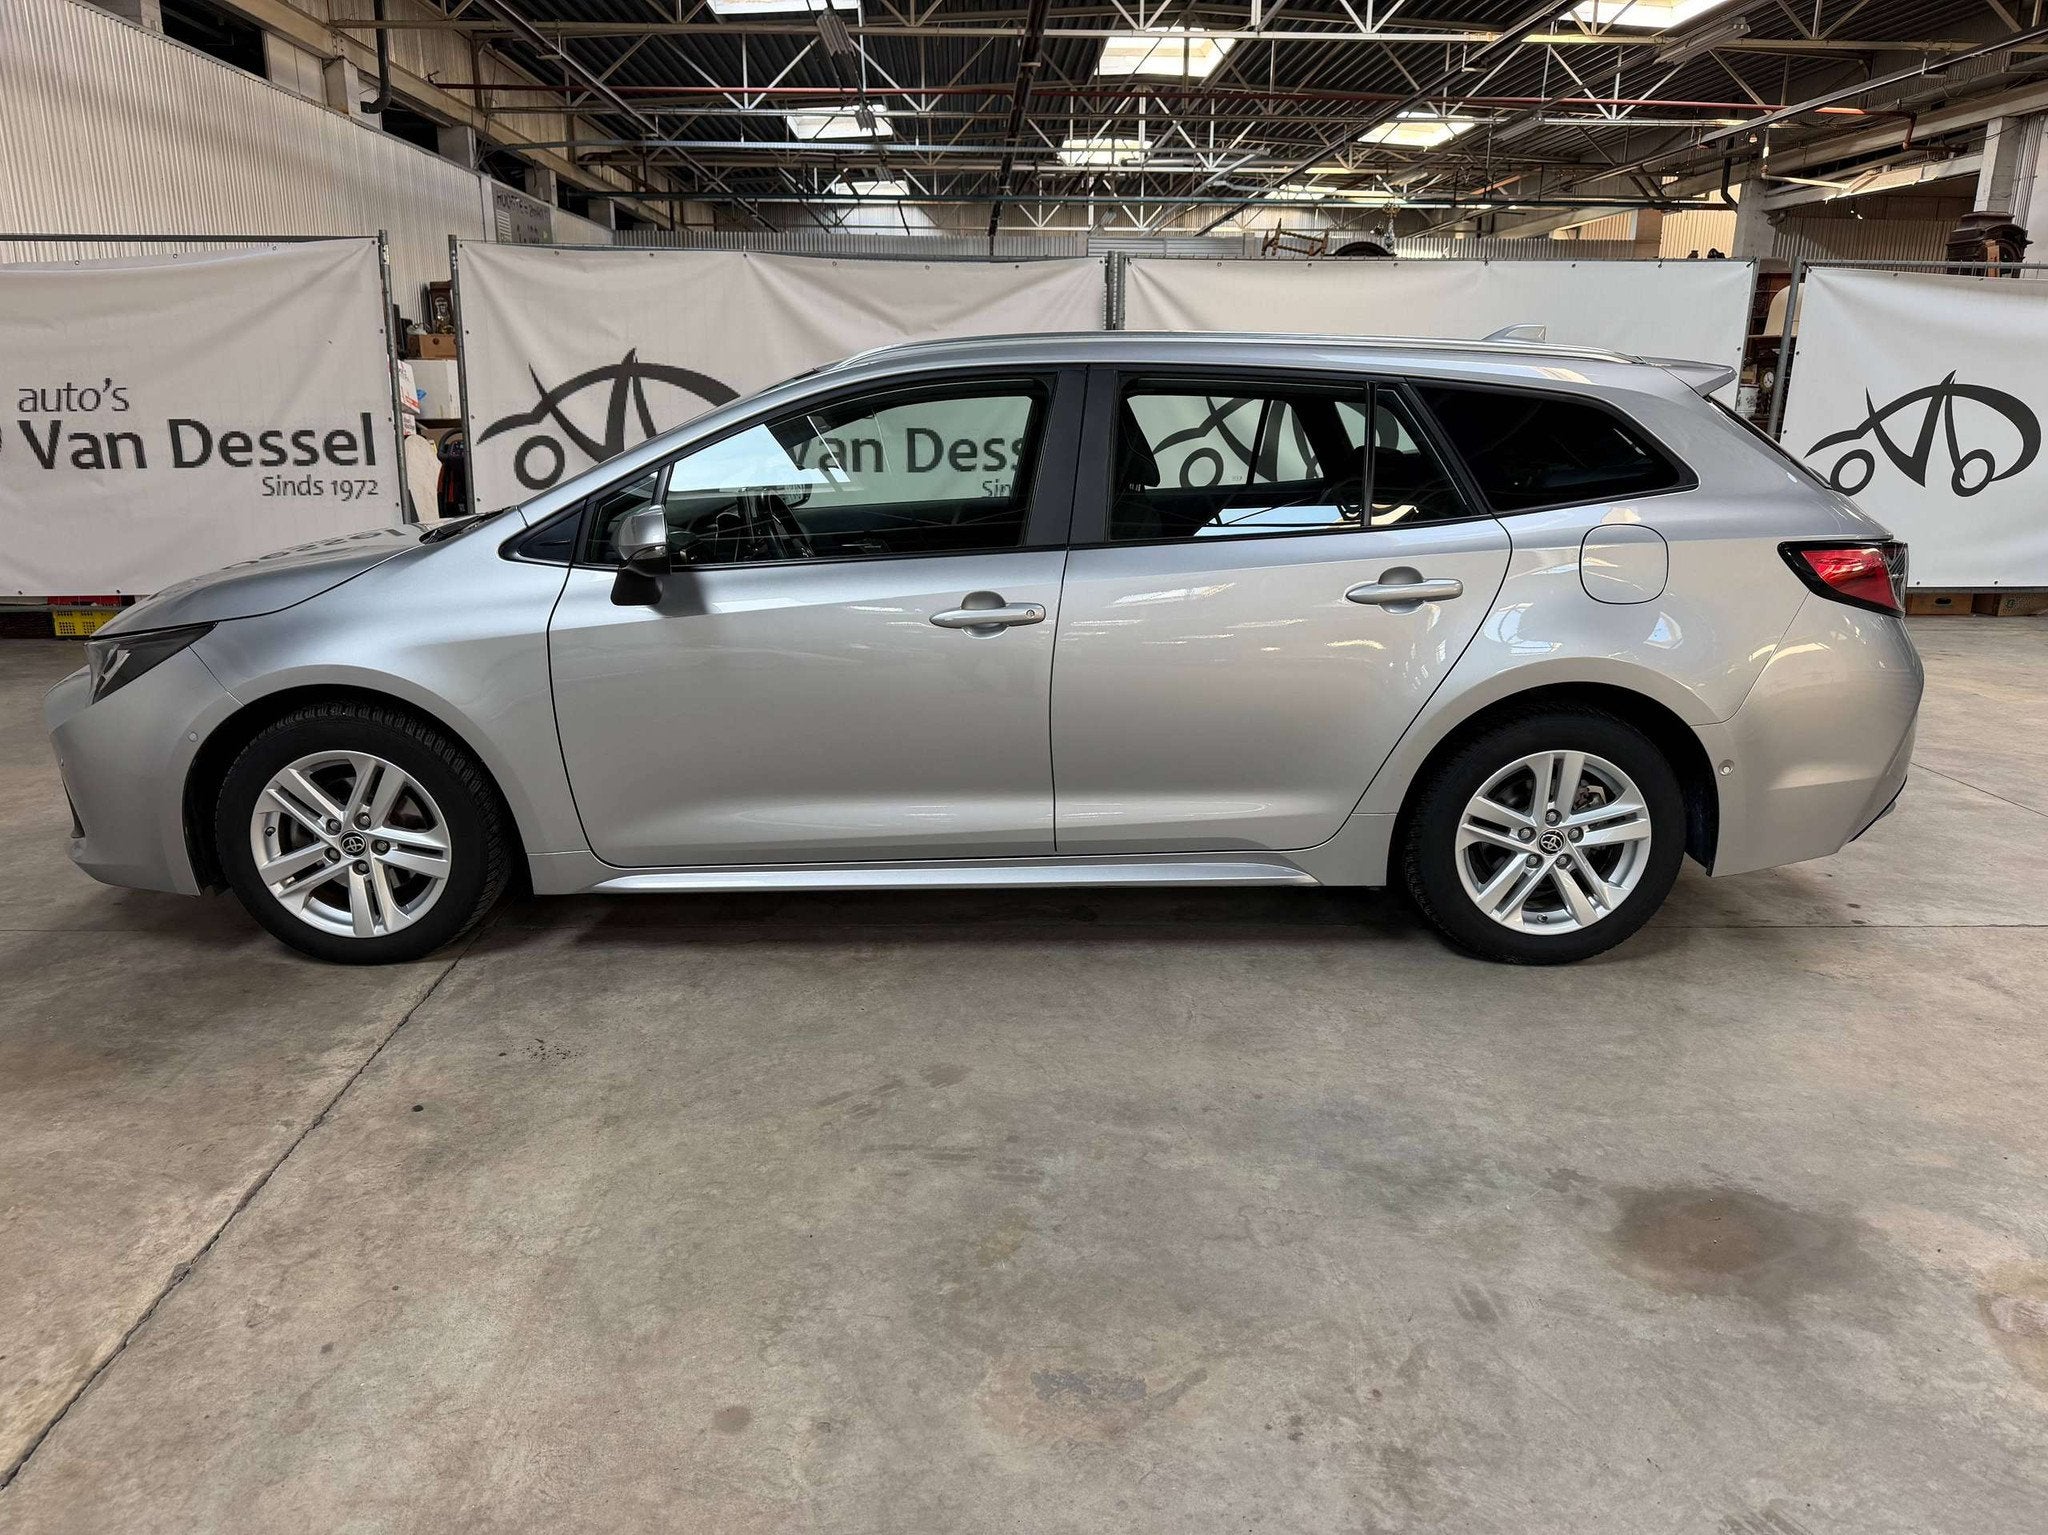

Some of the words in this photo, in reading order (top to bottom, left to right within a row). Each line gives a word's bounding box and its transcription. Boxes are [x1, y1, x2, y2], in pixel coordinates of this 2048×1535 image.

[17, 419, 148, 470] Van
[168, 411, 377, 469] Dessel
[262, 474, 324, 497] Sinds
[330, 479, 379, 502] 1972
